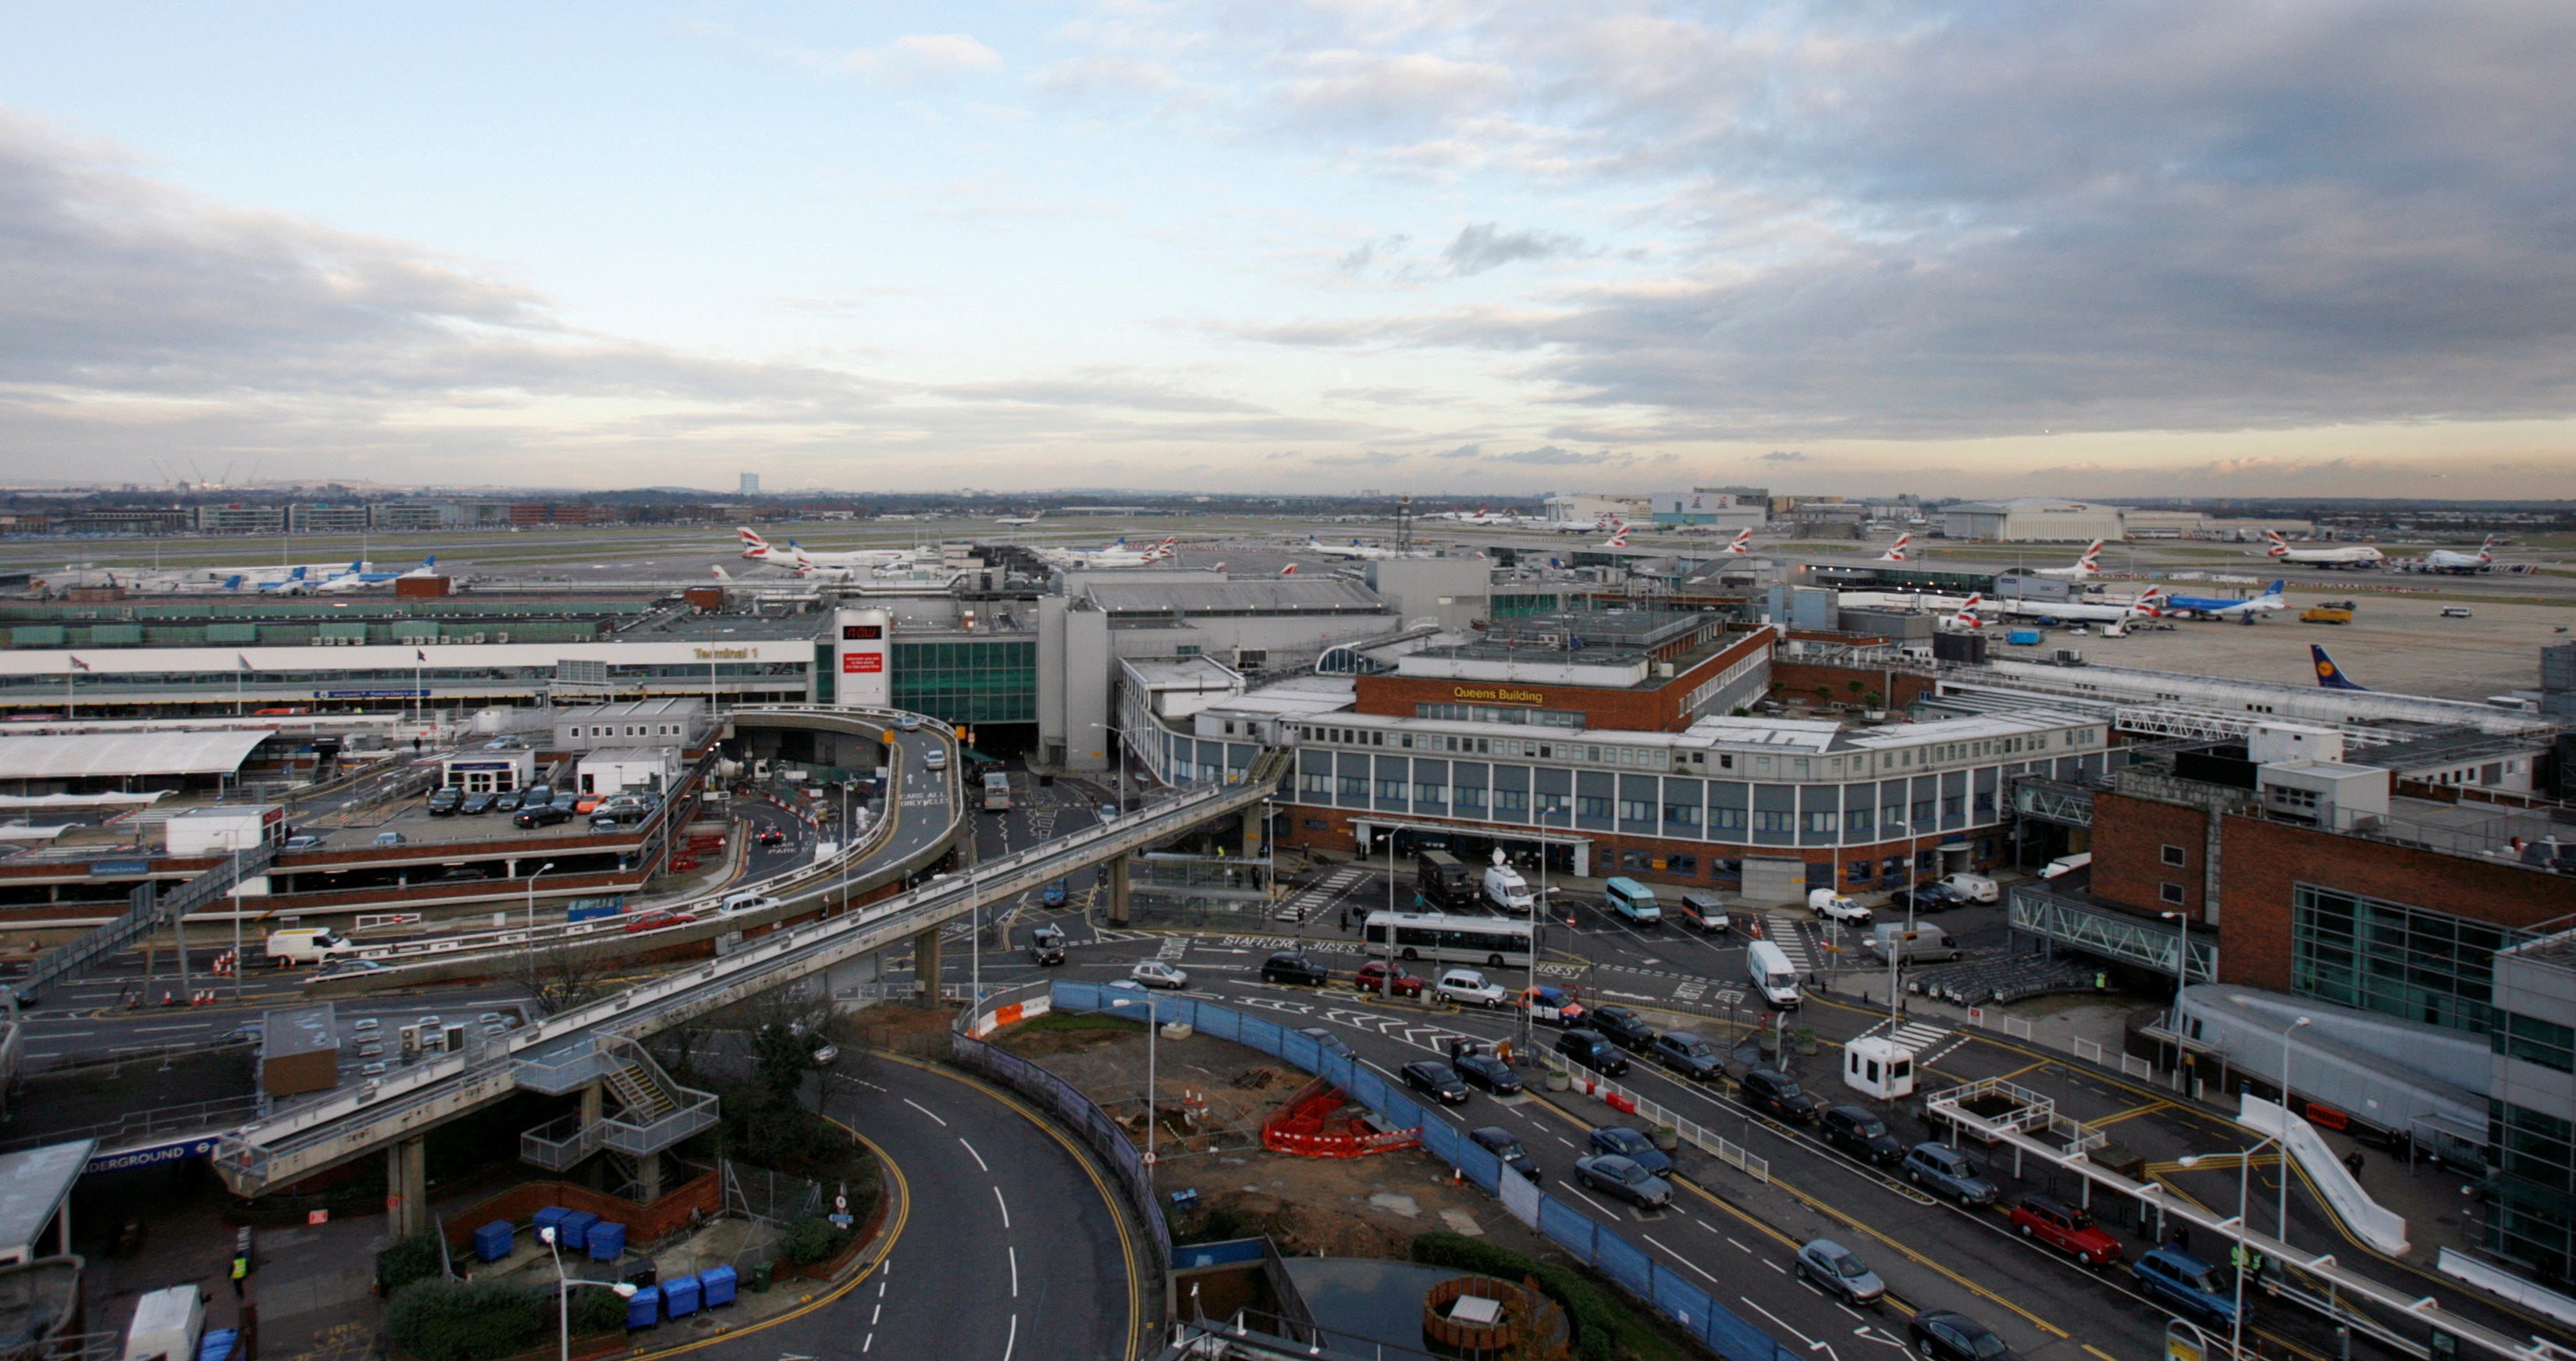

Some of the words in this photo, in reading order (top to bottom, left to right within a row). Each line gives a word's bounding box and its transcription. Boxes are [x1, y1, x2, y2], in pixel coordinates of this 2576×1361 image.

[694, 648, 747, 659] Terminal
[751, 648, 758, 658] 1
[1453, 687, 1496, 699] Queens
[1499, 689, 1543, 703] Building
[1223, 936, 1305, 948] STAFF/CRE
[80, 1147, 184, 1174] NDERGROUND
